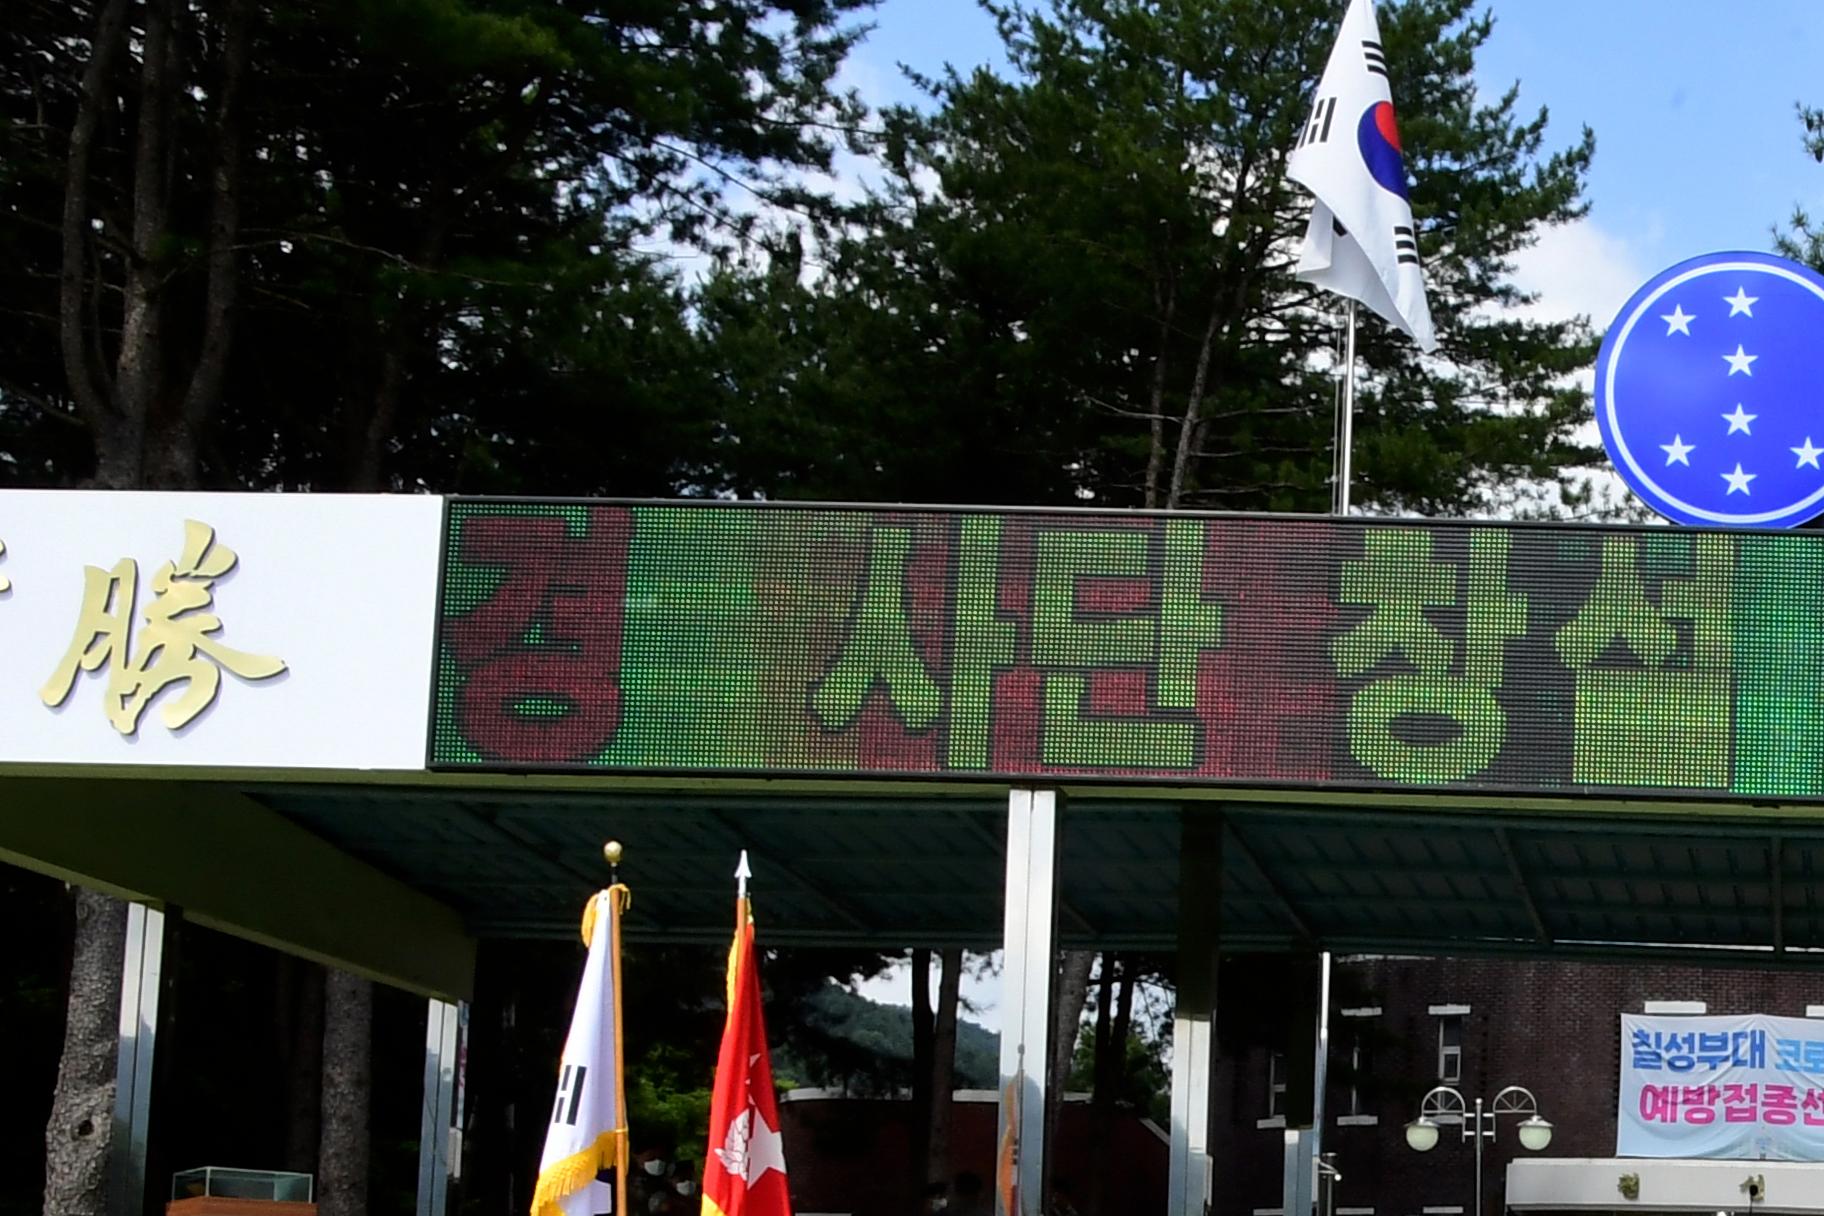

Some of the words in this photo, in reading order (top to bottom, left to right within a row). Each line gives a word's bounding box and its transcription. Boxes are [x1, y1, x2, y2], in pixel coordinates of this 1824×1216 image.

[0, 519, 289, 735] 勝
[451, 505, 633, 765] 경
[812, 514, 1223, 770] 사단
[1329, 525, 1735, 788] 창설
[1632, 1029, 1765, 1073] 칠성부대
